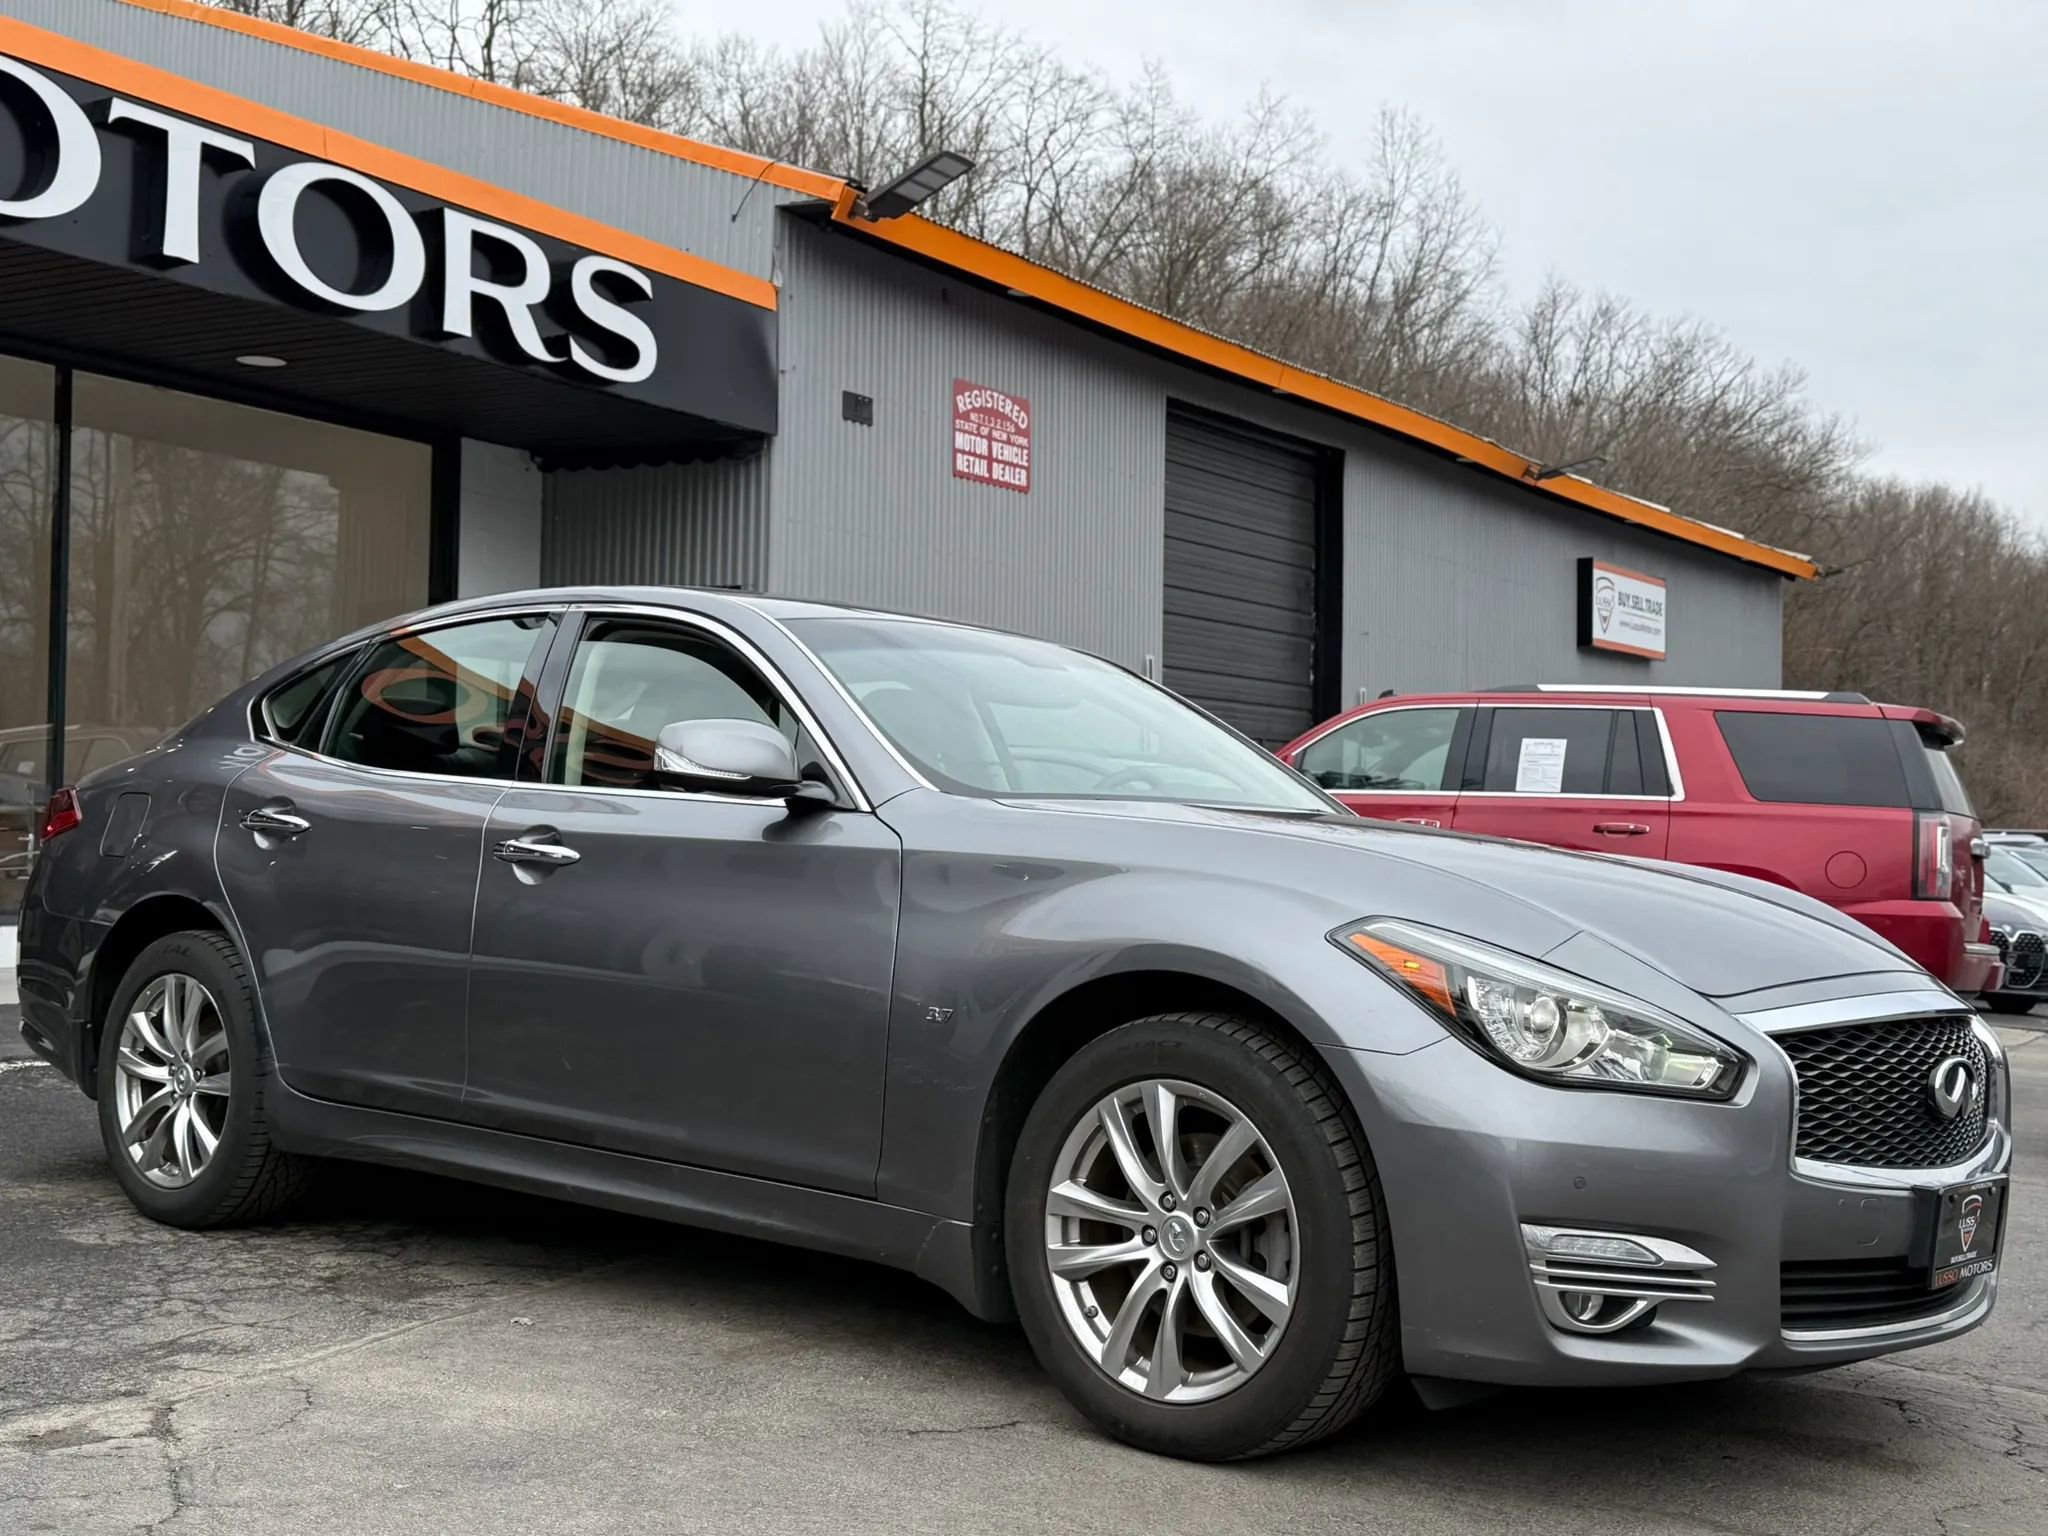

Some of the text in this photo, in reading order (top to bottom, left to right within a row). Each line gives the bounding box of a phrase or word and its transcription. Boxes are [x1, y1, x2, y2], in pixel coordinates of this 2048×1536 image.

[956, 389, 1029, 429] REGISTERED
[955, 419, 1029, 447] STATE OF NEW YORK
[955, 431, 1028, 467] MOTOR VEHICLE
[956, 453, 1027, 487] RETAIL DEALER
[1960, 1260, 1993, 1279] MOTORS
